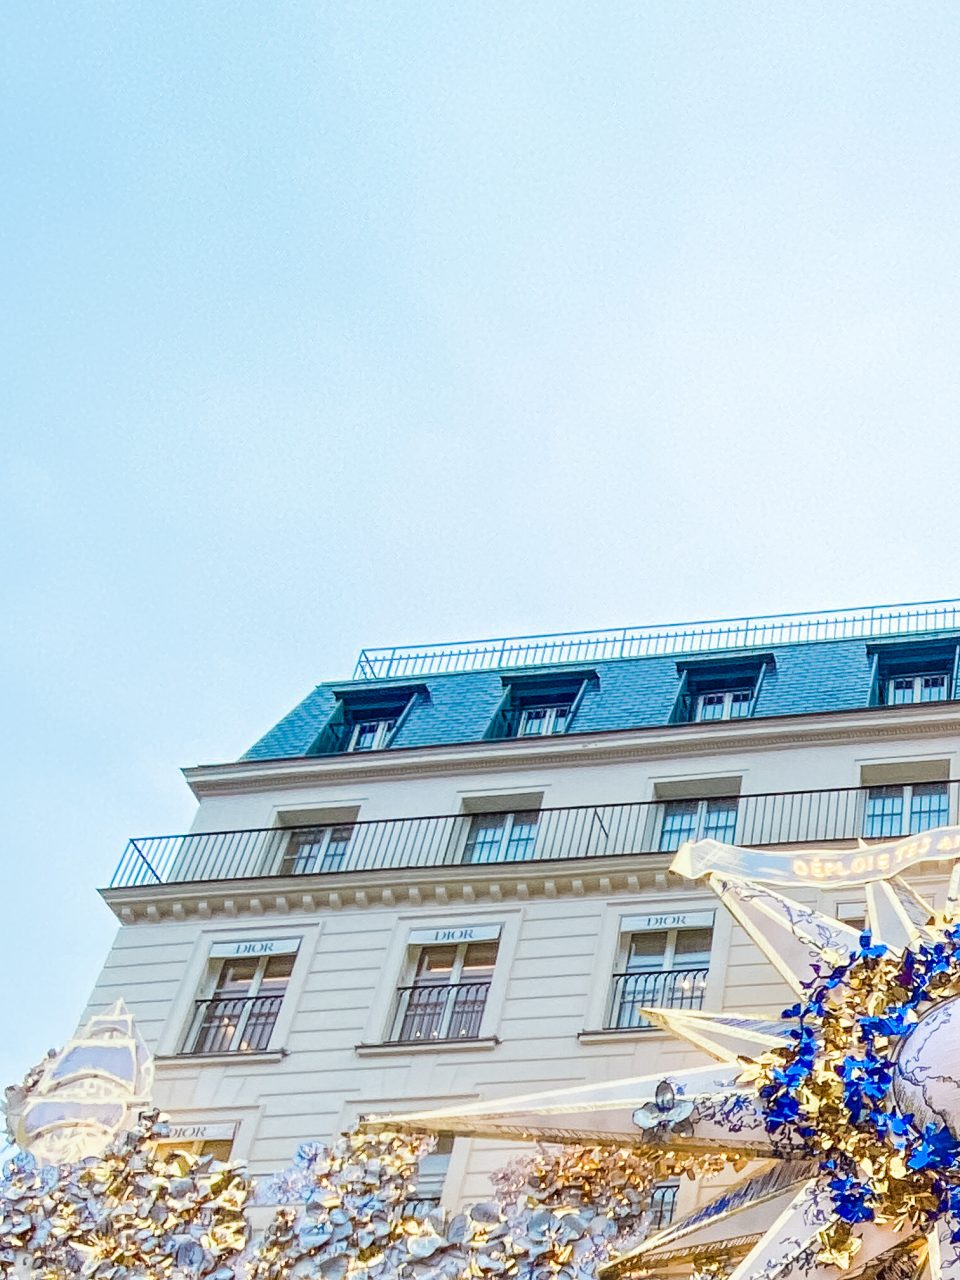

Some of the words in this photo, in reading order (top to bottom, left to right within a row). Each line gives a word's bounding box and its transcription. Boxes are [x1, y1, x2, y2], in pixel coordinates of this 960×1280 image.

[646, 915, 687, 927] DIOR
[434, 928, 475, 941] DIOR
[235, 942, 275, 954] DIOR
